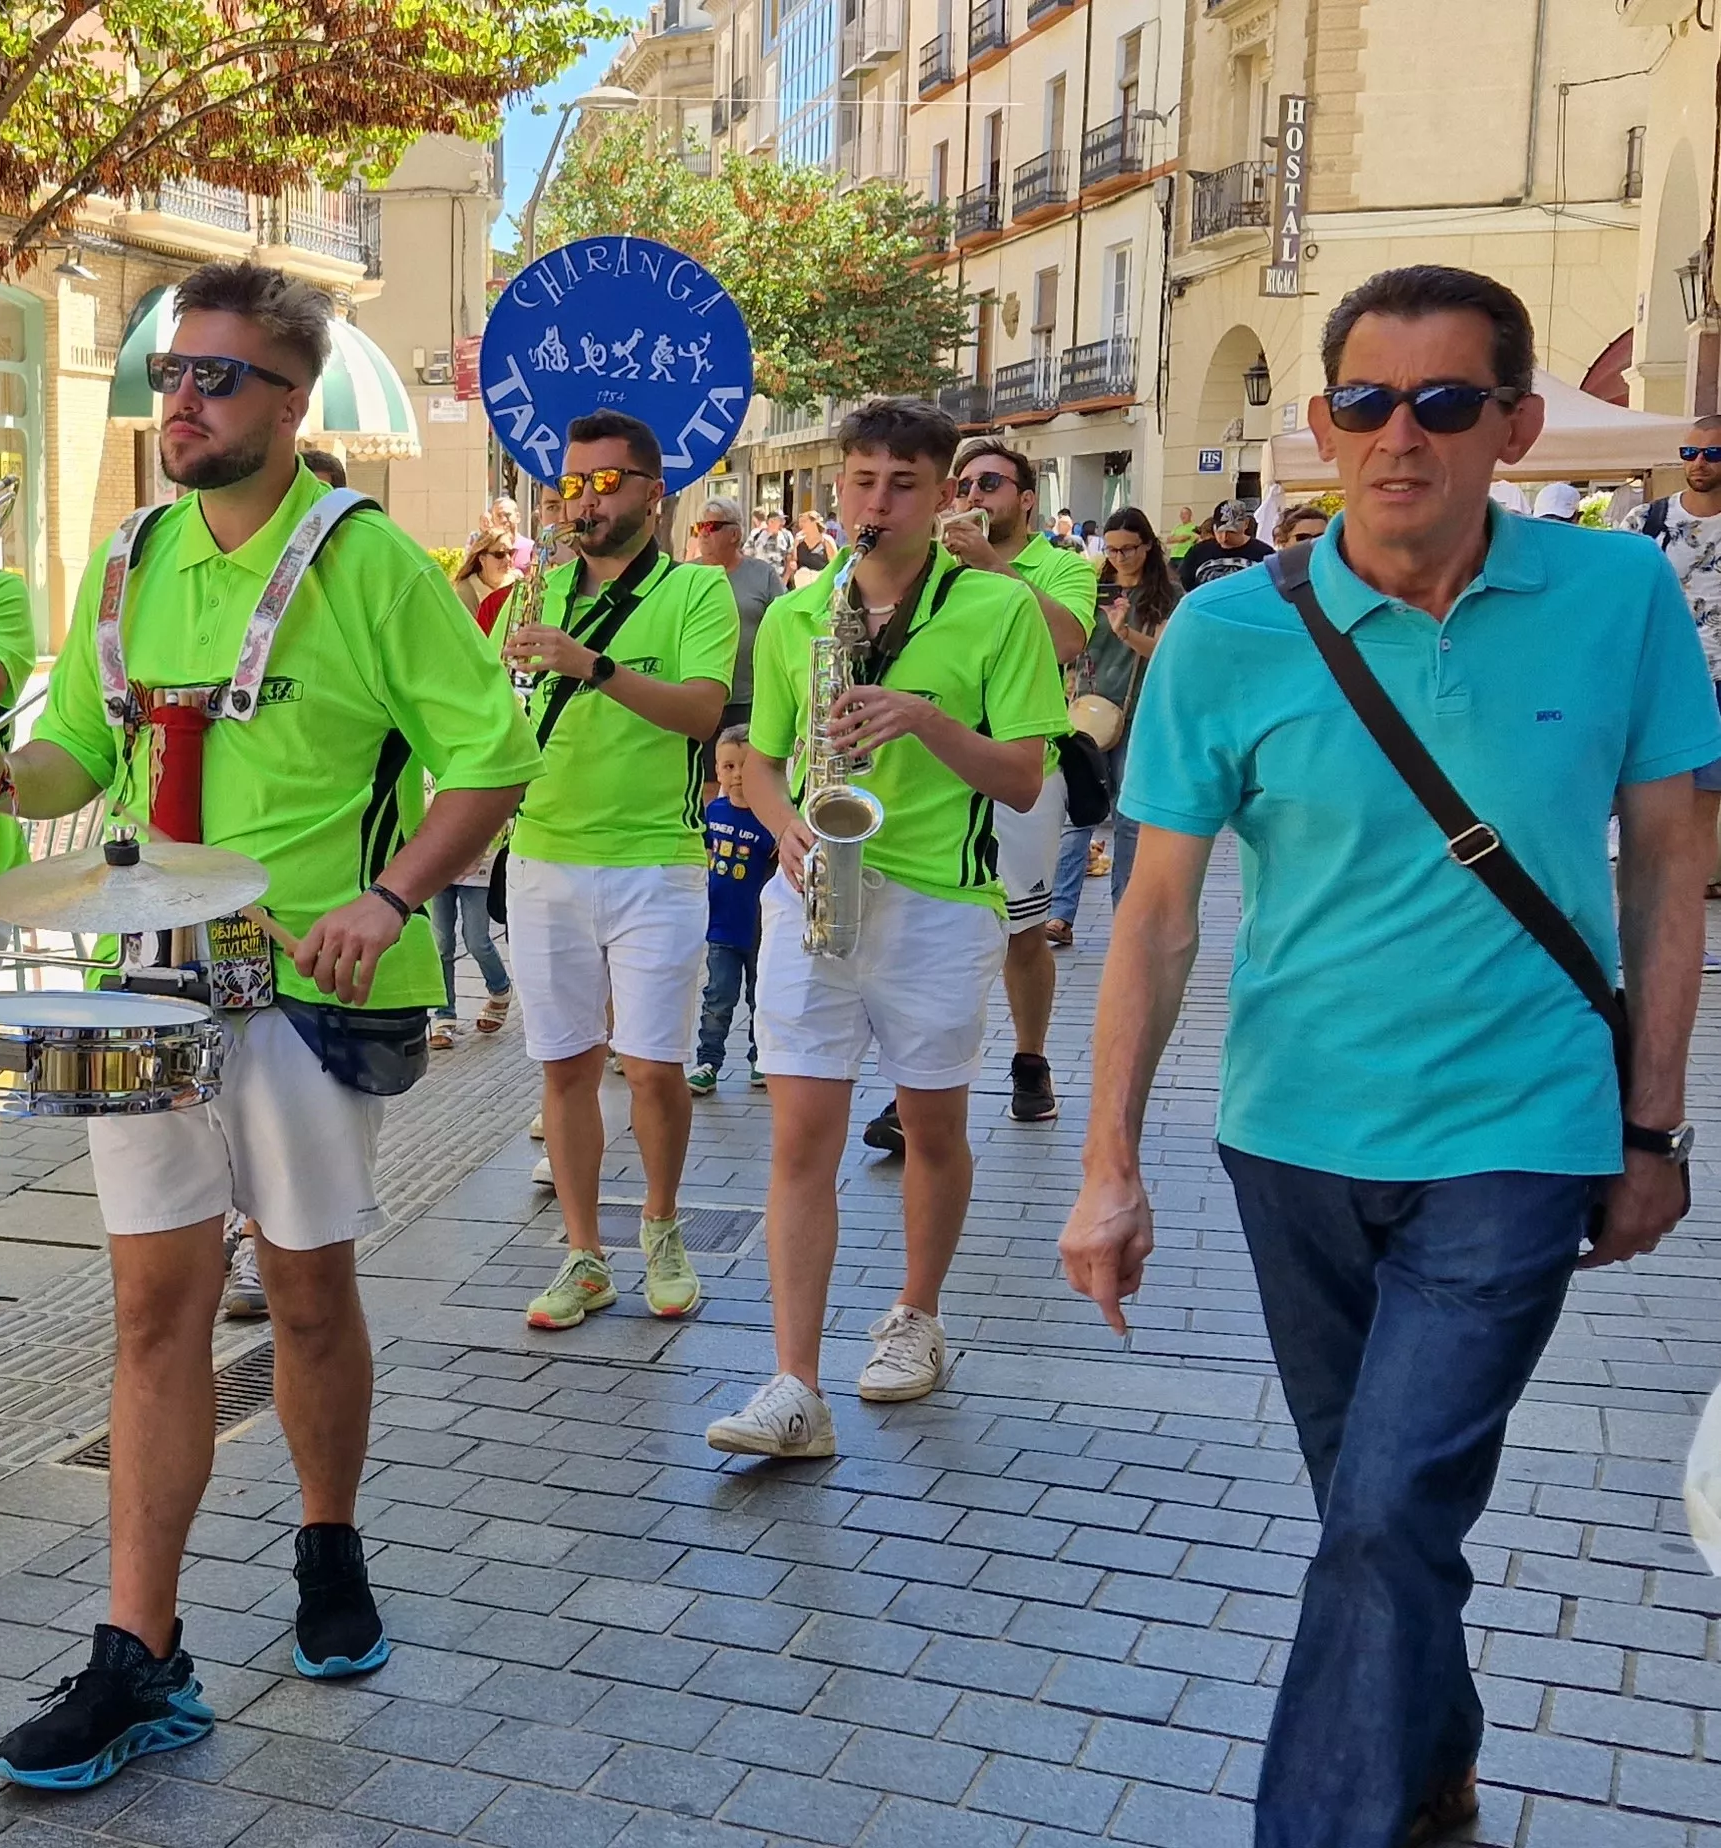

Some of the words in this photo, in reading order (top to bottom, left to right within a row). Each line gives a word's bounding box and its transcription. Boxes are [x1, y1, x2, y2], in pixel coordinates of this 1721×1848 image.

[1281, 98, 1306, 263] HOSTAL
[512, 238, 727, 319] CHARANGA
[1265, 268, 1299, 294] RUGACA
[1201, 451, 1221, 464] HS
